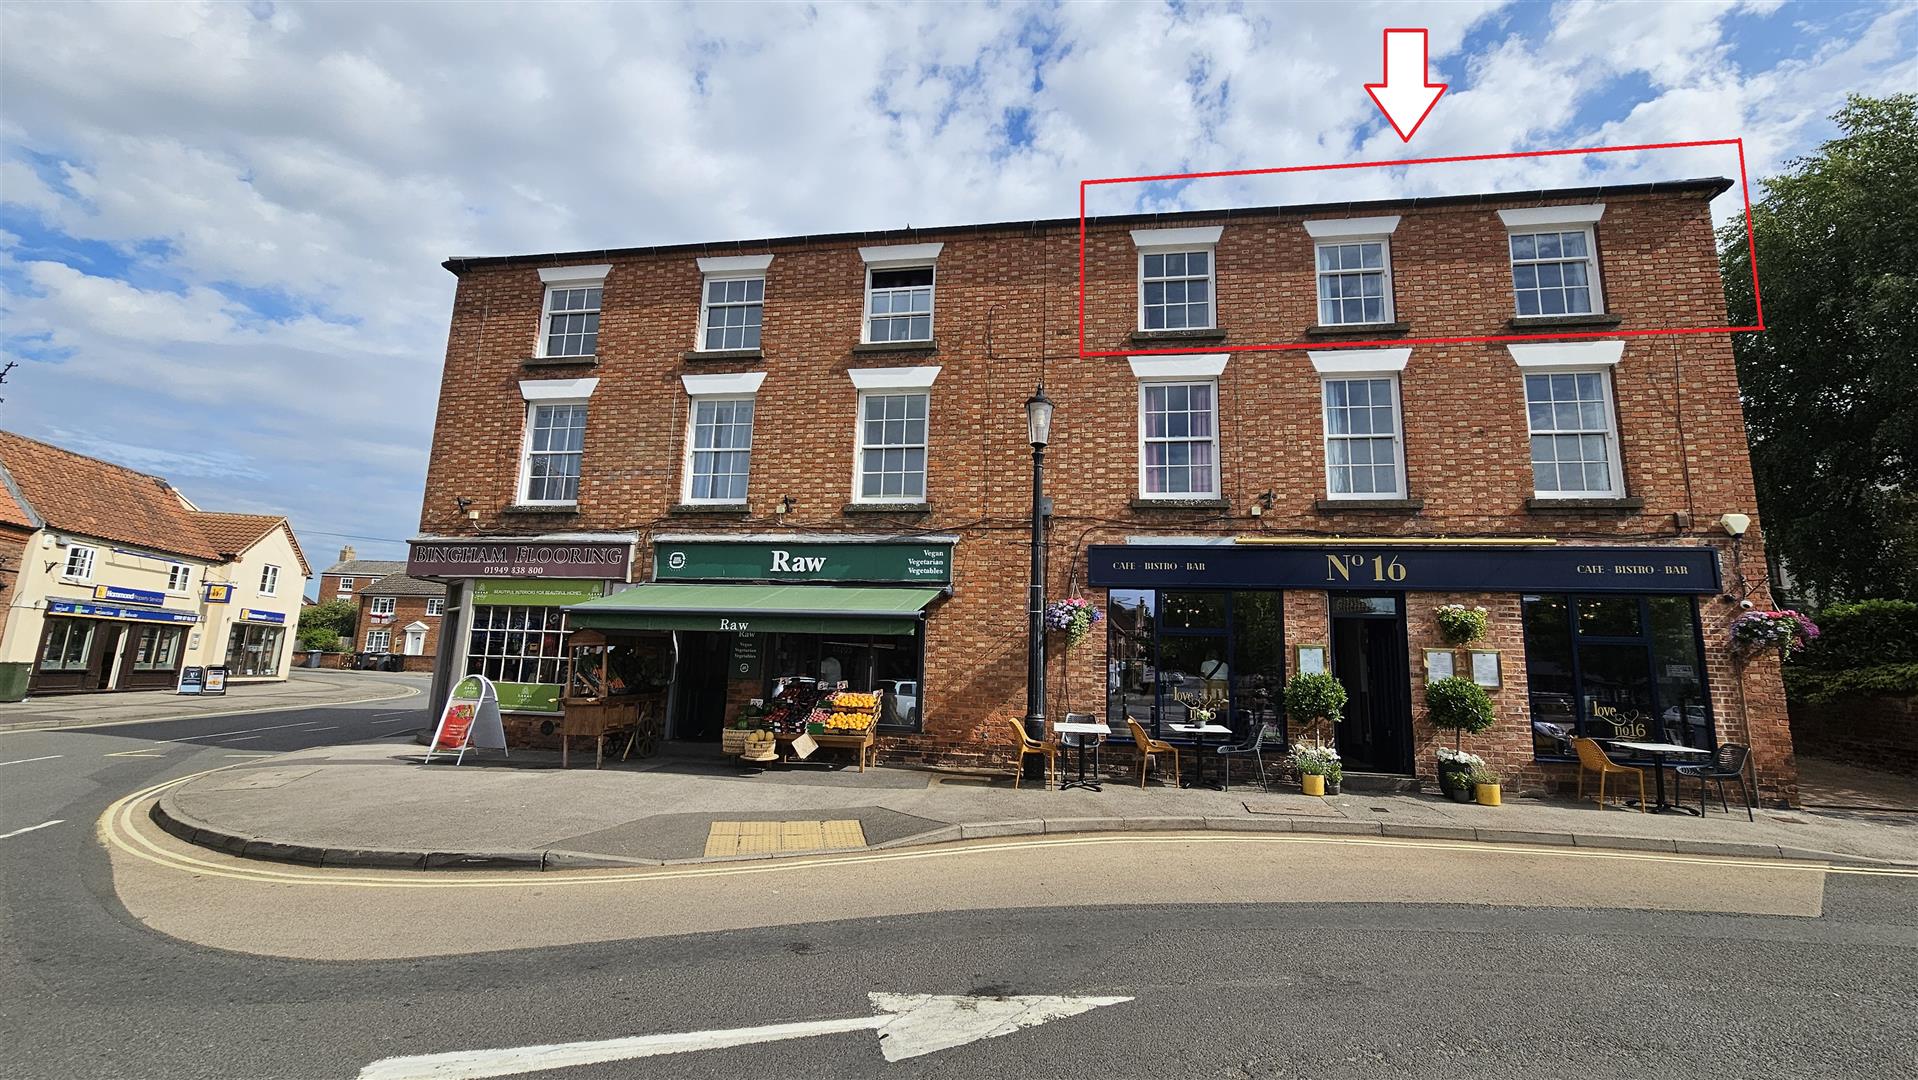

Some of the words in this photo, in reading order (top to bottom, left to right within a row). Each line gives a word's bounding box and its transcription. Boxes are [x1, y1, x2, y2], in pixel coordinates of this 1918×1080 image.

[414, 546, 507, 563] BINGHAM
[515, 546, 623, 564] FLOORING
[923, 550, 944, 558] Vegan
[770, 550, 826, 572] Raw
[908, 559, 944, 567] Vegetarian
[1112, 561, 1136, 570] CAFE
[1144, 562, 1178, 570] BISTRO
[1186, 562, 1206, 571] BAR
[484, 566, 509, 575] 01949
[527, 566, 544, 575] 800
[908, 567, 944, 575] Vegetables
[1372, 555, 1407, 582] 16
[1576, 565, 1605, 574] CAFE
[1614, 565, 1655, 574] BISTRO
[1664, 565, 1689, 575] BAR
[720, 618, 749, 630] Raw
[1173, 686, 1194, 701] love
[1593, 700, 1617, 717] love
[1614, 723, 1646, 737] no16
